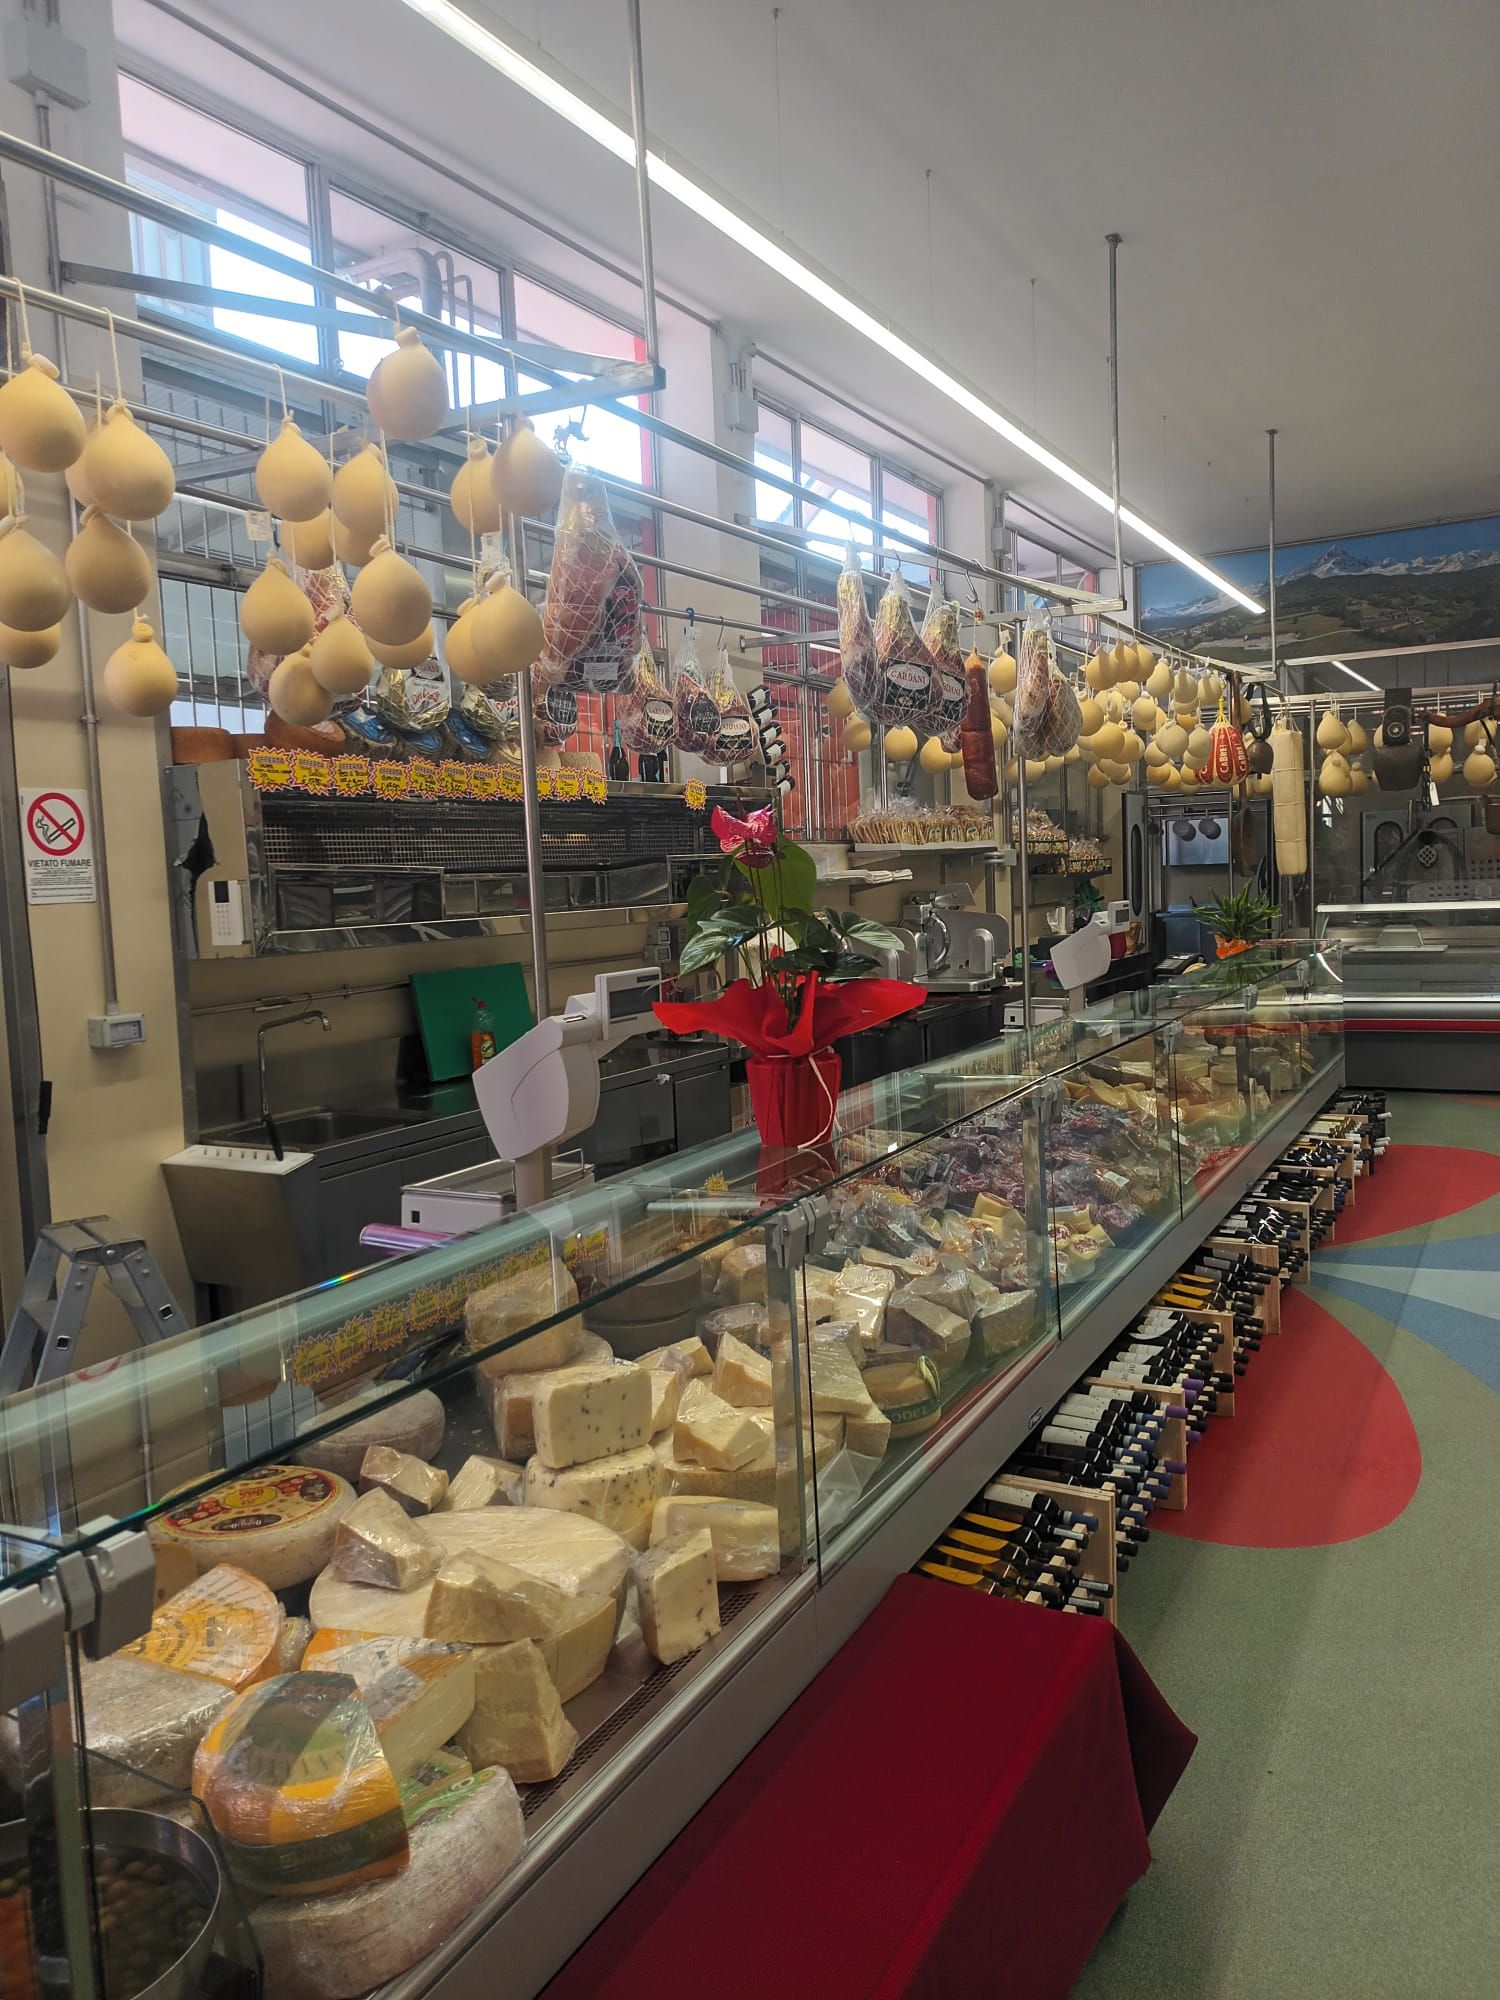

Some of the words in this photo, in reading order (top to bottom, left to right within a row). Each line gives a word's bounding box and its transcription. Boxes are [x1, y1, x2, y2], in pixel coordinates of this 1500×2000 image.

[890, 670, 927, 684] GARDANI
[28, 859, 59, 868] VIETATO
[60, 859, 92, 868] FUMARE
